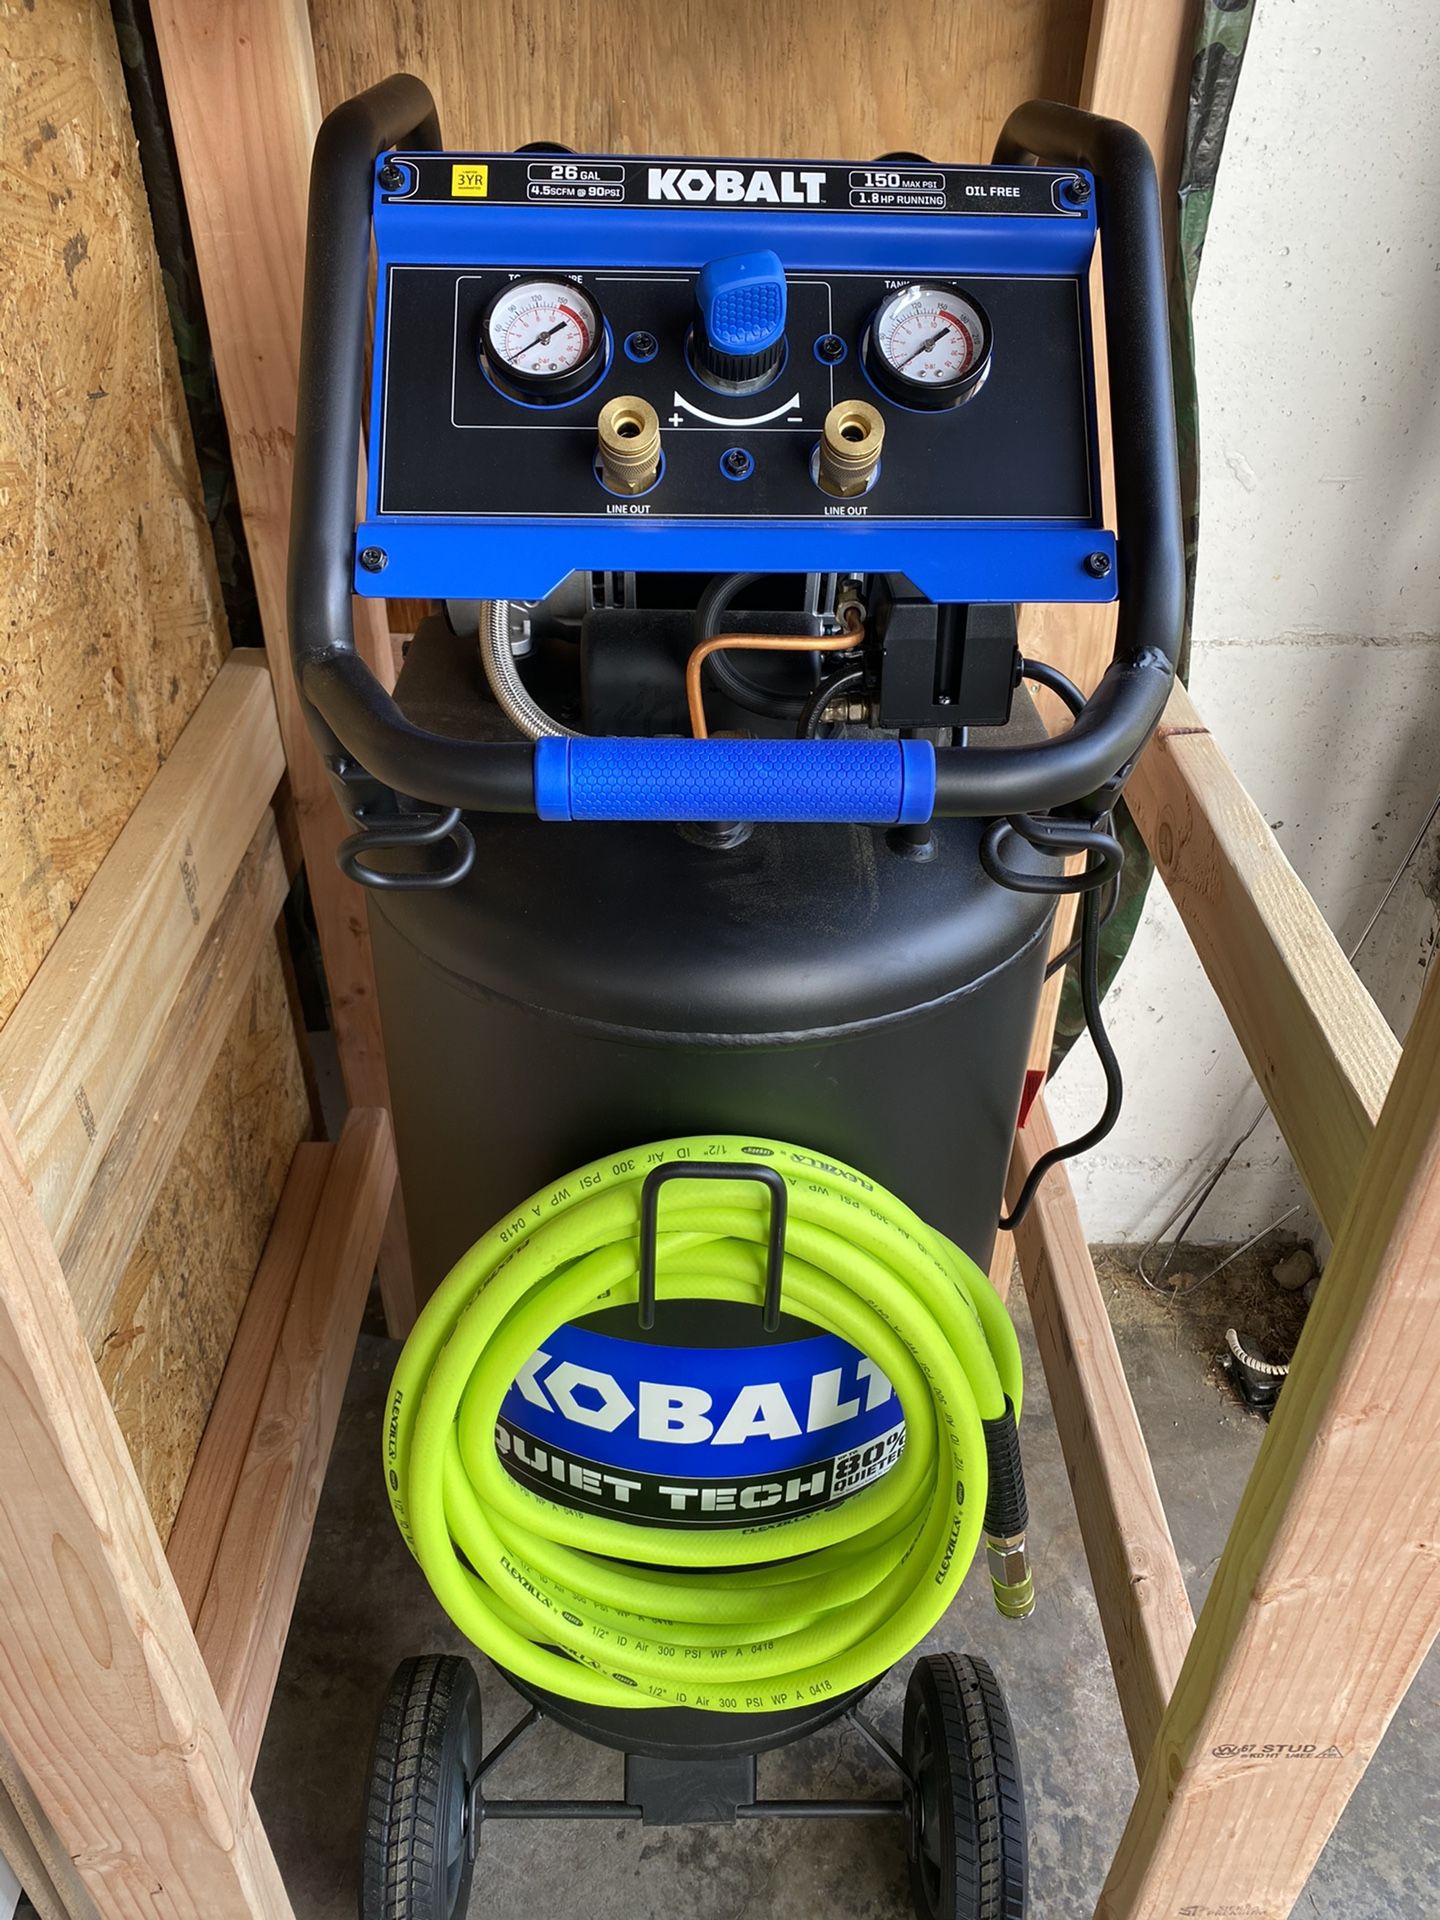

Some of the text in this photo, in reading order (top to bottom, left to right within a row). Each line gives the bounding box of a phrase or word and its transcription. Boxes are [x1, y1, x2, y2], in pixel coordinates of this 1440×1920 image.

[551, 165, 600, 181] 26 GAL
[648, 168, 826, 203] KOBALT
[864, 173, 937, 189] 150 MAX PSI
[965, 186, 1020, 197] OIL FREE
[897, 195, 943, 206] RUNNING
[606, 504, 650, 514] LINE OUT
[824, 506, 868, 516] LINE OUT
[677, 1147, 690, 1158] ID
[704, 1144, 727, 1155] 1/2"
[647, 1151, 664, 1163] Air
[612, 1159, 636, 1176] 300
[579, 1171, 602, 1190] PSI
[788, 1177, 797, 1186] A
[808, 1184, 829, 1196] WP
[550, 1188, 571, 1206] WP
[840, 1195, 860, 1209] PSI
[531, 1205, 541, 1216] A
[499, 1217, 526, 1243] 0418
[658, 1470, 826, 1511] TECH
[500, 1556, 552, 1608] FLEXZILLA
[592, 1626, 609, 1639] 1/2"
[617, 1635, 628, 1647] ID
[635, 1640, 649, 1652] Air
[658, 1646, 675, 1657] 300
[684, 1649, 702, 1659] PSI
[711, 1649, 728, 1659] WP
[735, 1647, 743, 1657] A
[751, 1641, 774, 1654] 0418
[648, 1685, 667, 1697] 1/2"
[676, 1692, 687, 1703] ID
[695, 1695, 710, 1706] Air
[719, 1698, 737, 1709] 300
[746, 1696, 764, 1708] PSI
[771, 1694, 788, 1706] WP
[795, 1690, 804, 1701] A
[809, 1680, 833, 1697] 0418
[1240, 1744, 1257, 1753] 67
[1262, 1744, 1317, 1753] STUD
